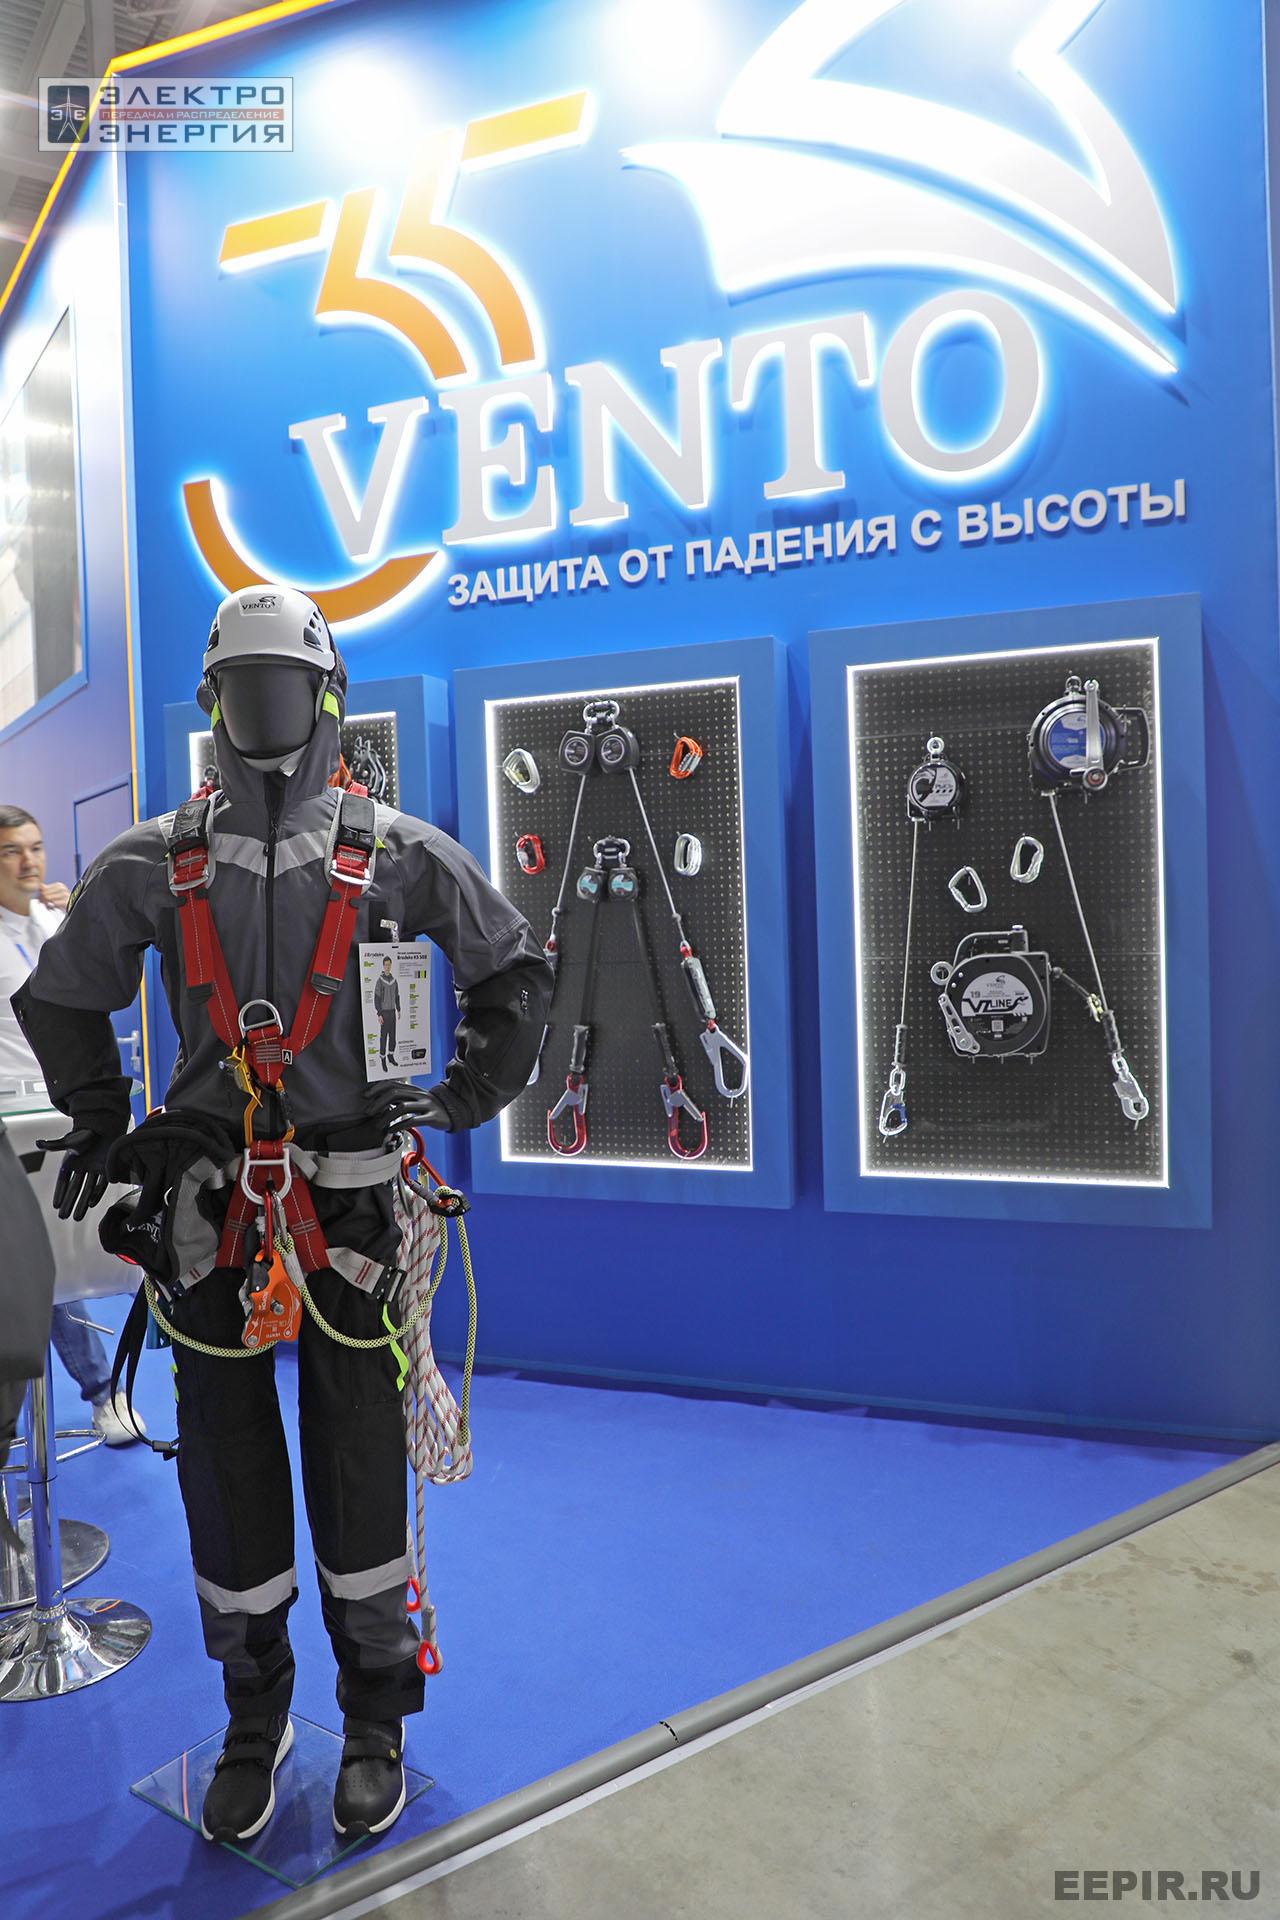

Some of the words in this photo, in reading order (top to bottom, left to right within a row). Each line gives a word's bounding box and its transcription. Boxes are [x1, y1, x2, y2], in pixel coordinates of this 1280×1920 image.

[289, 289, 1040, 557] VENTO
[447, 554, 609, 606] ЗАЩИТА
[618, 545, 673, 583] ОТ
[685, 514, 897, 575] ПАДЕНИЯ
[910, 509, 942, 547] С
[957, 478, 1186, 543] ВЫСОТЫ
[241, 602, 271, 610] VENTO
[125, 1222, 162, 1240] VENT
